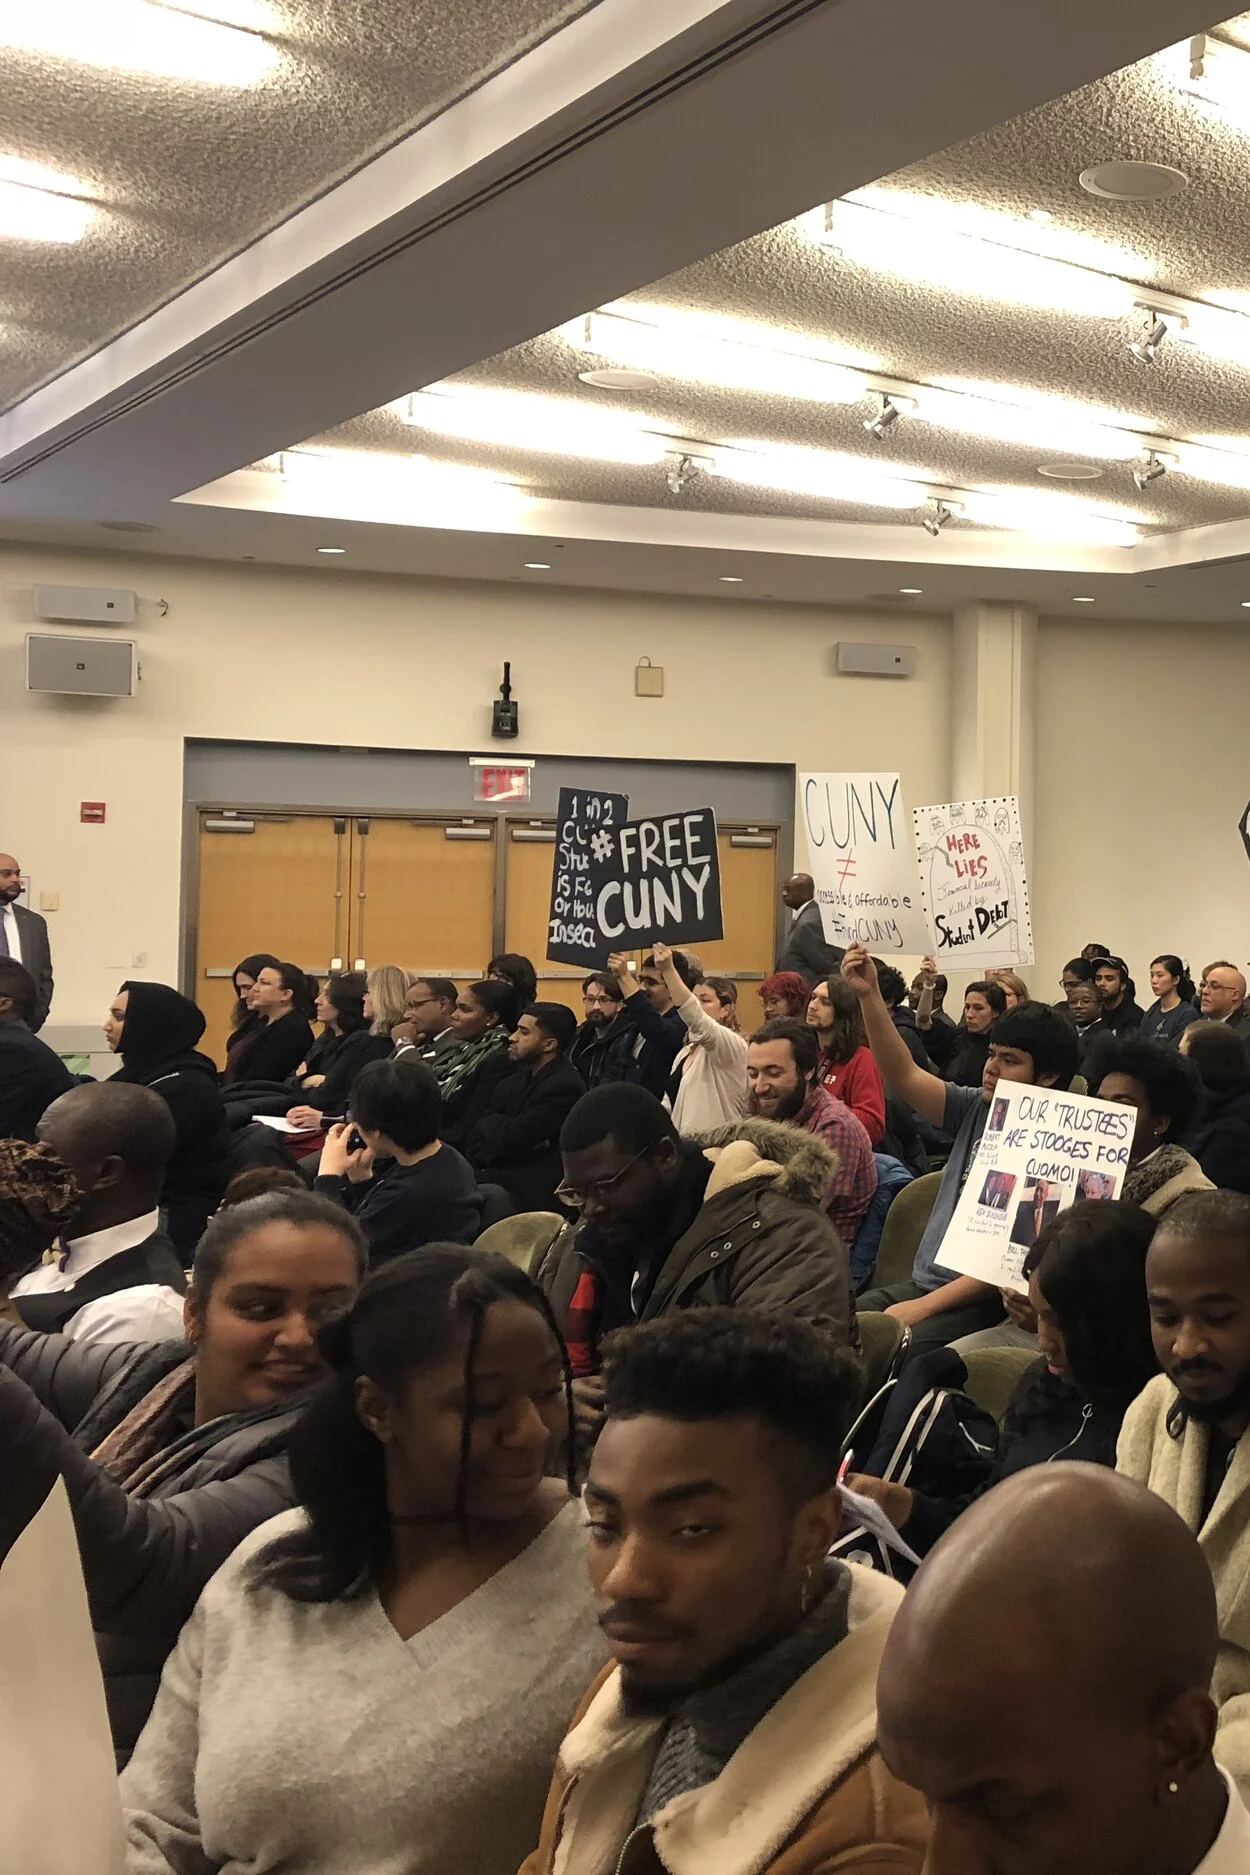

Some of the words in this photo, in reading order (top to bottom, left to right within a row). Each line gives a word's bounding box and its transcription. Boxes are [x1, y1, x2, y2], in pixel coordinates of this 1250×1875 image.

[571, 796, 578, 818] 1
[585, 796, 600, 819] in
[602, 799, 613, 825] 2
[805, 778, 899, 850] CUNY
[946, 832, 981, 854] HERE
[557, 871, 571, 896] is
[597, 863, 711, 938] CUNY
[1018, 1096, 1050, 1124] OUR
[1002, 1128, 1029, 1148] ARE
[1030, 1130, 1092, 1160] STOOGES
[1096, 1147, 1129, 1165] FOR
[1025, 1158, 1075, 1188] CUOMO!
